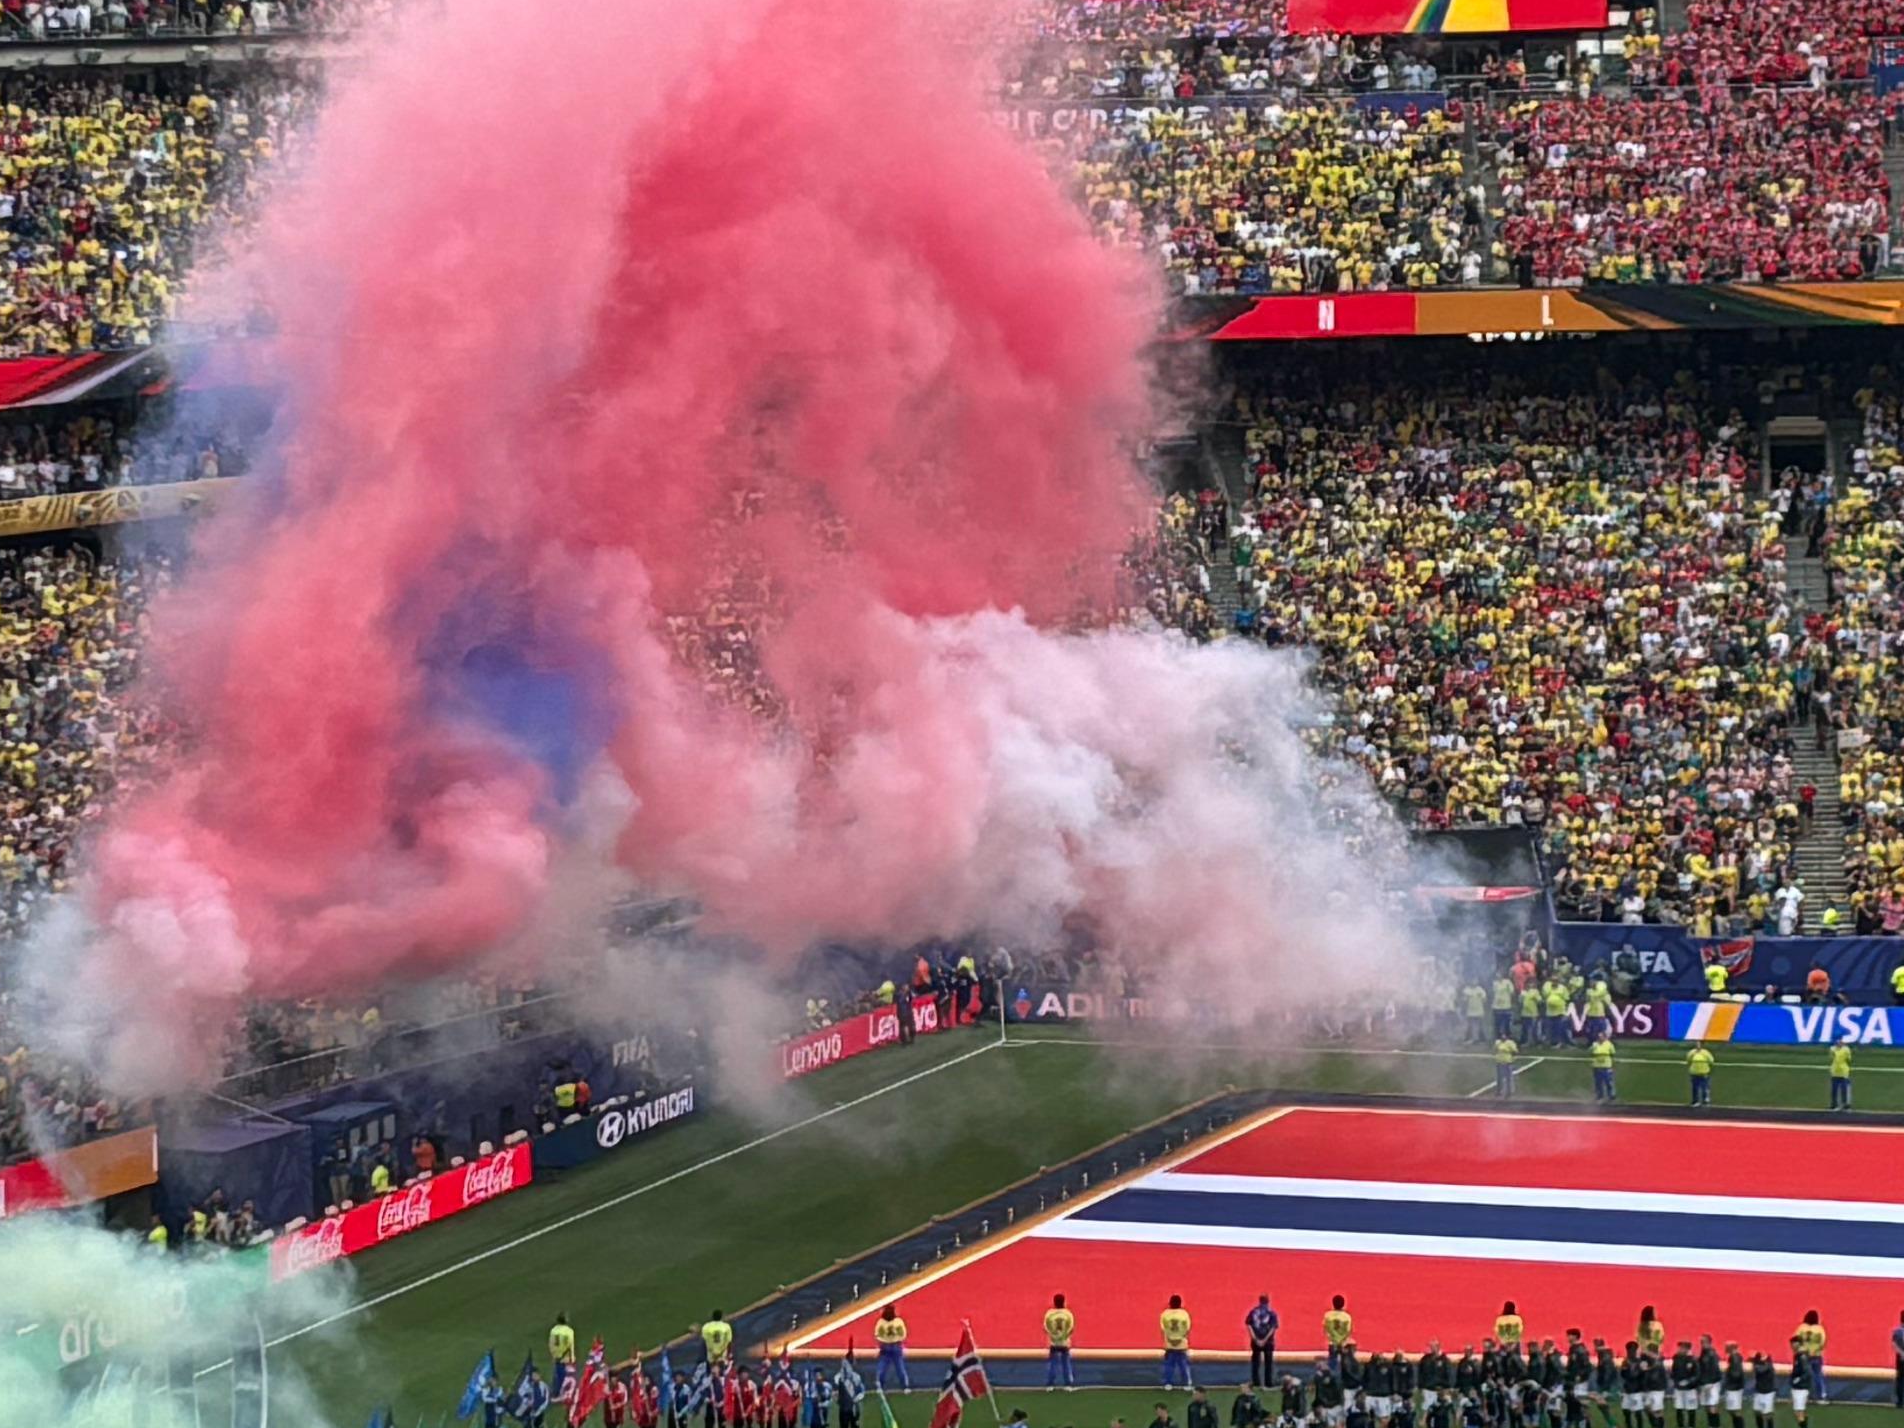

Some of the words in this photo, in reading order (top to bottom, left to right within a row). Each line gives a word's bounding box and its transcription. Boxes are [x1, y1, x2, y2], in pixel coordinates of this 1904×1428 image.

[1611, 949, 1675, 974] FFA
[868, 1003, 938, 1045] Lenvo
[1781, 1005, 1894, 1045] VISA
[782, 1033, 843, 1076] Lenovo
[627, 1086, 694, 1135] HYUNDAI
